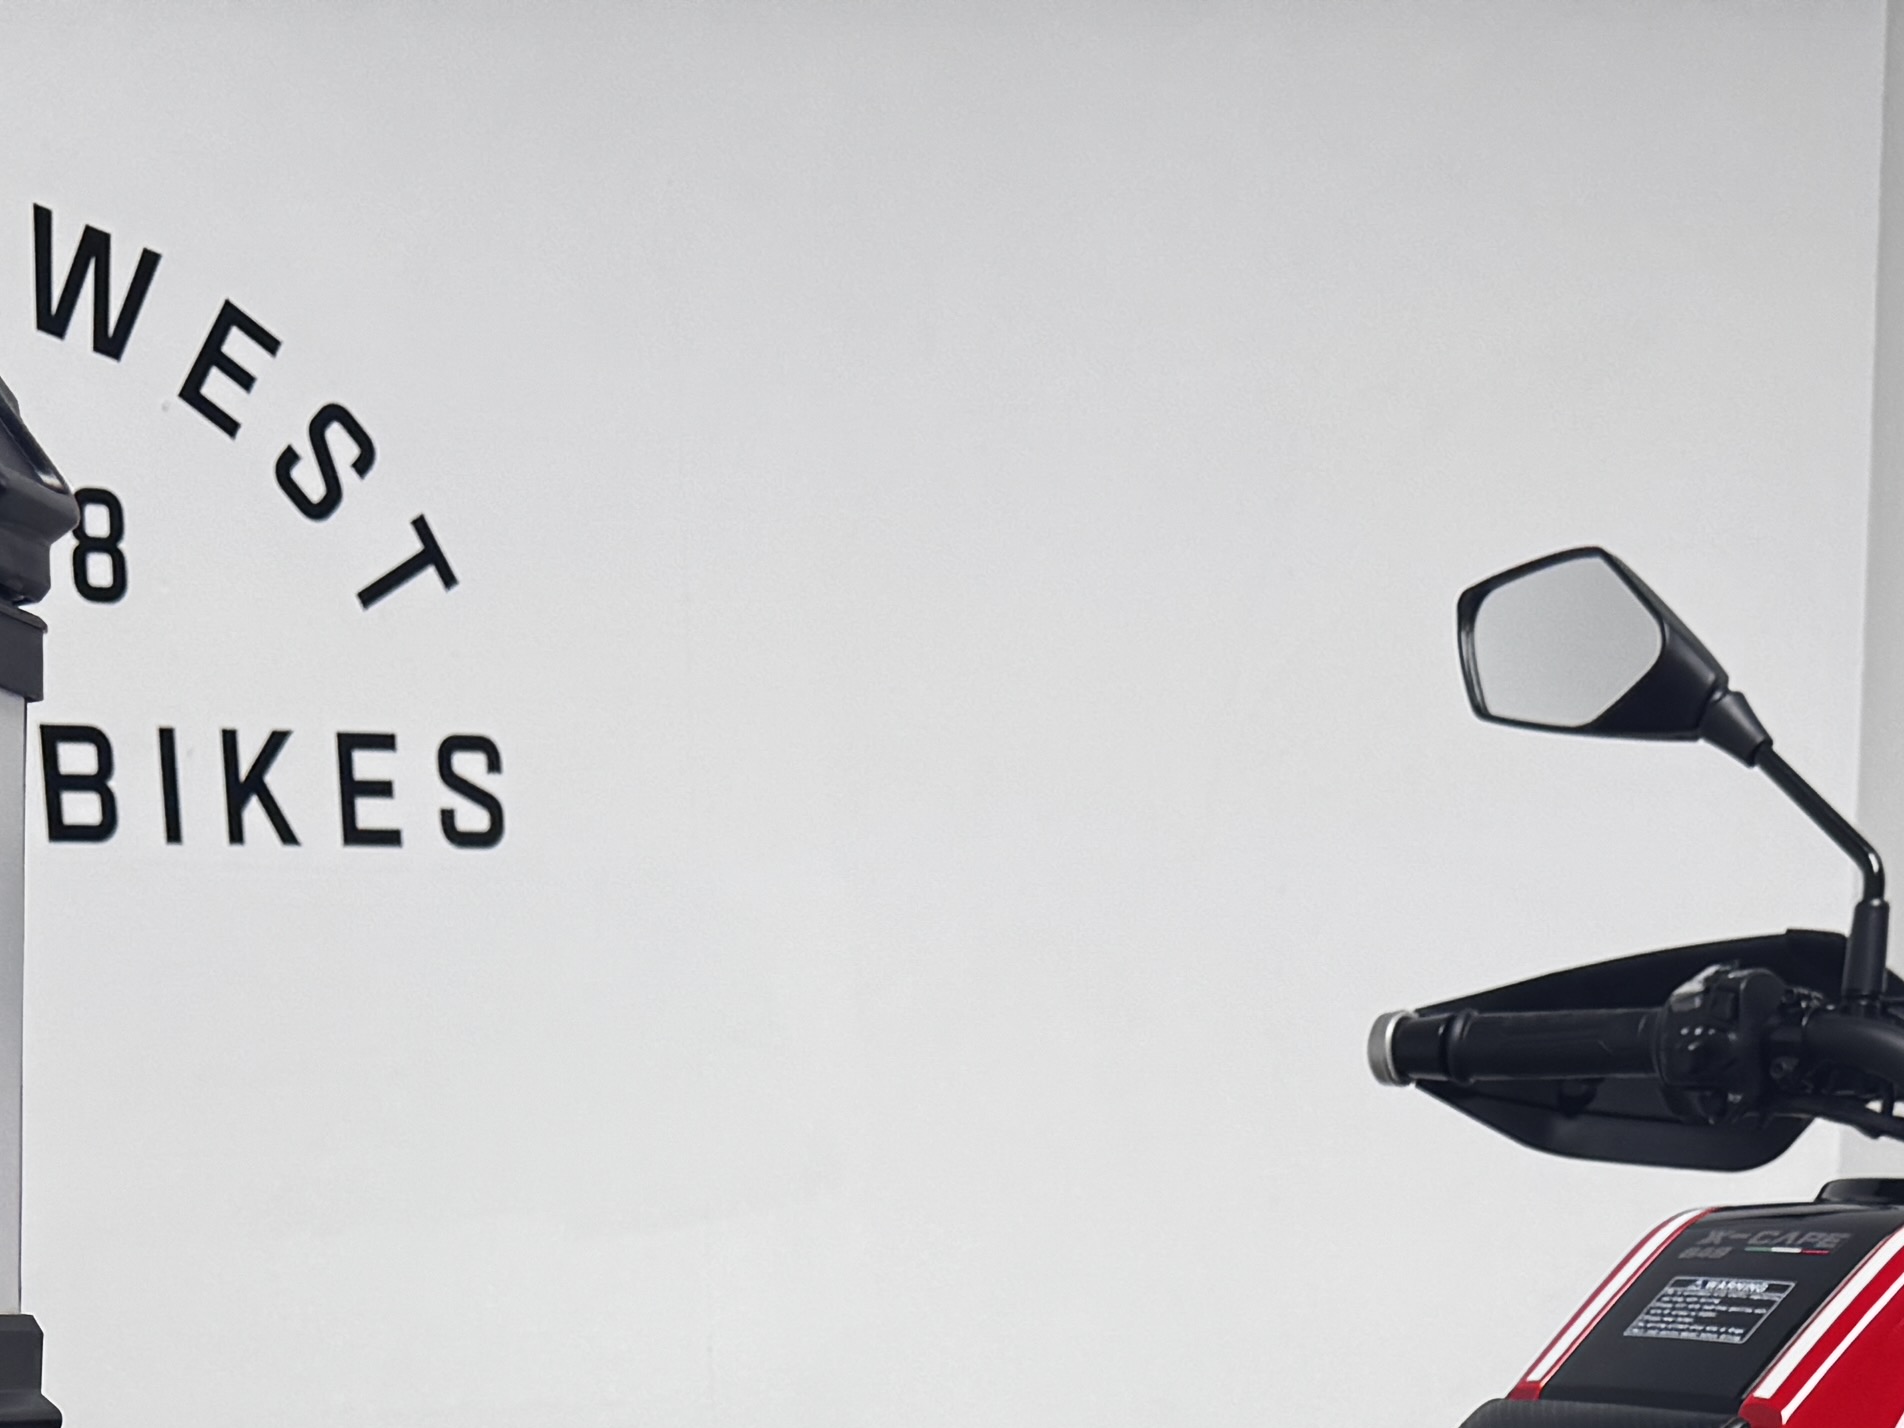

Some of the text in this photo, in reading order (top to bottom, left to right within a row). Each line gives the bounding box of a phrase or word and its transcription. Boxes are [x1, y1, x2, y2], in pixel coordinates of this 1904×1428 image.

[39, 723, 505, 849] BIKES
[1695, 1229, 1853, 1249] X-CAPE
[1704, 1278, 1769, 1293] WARNING
